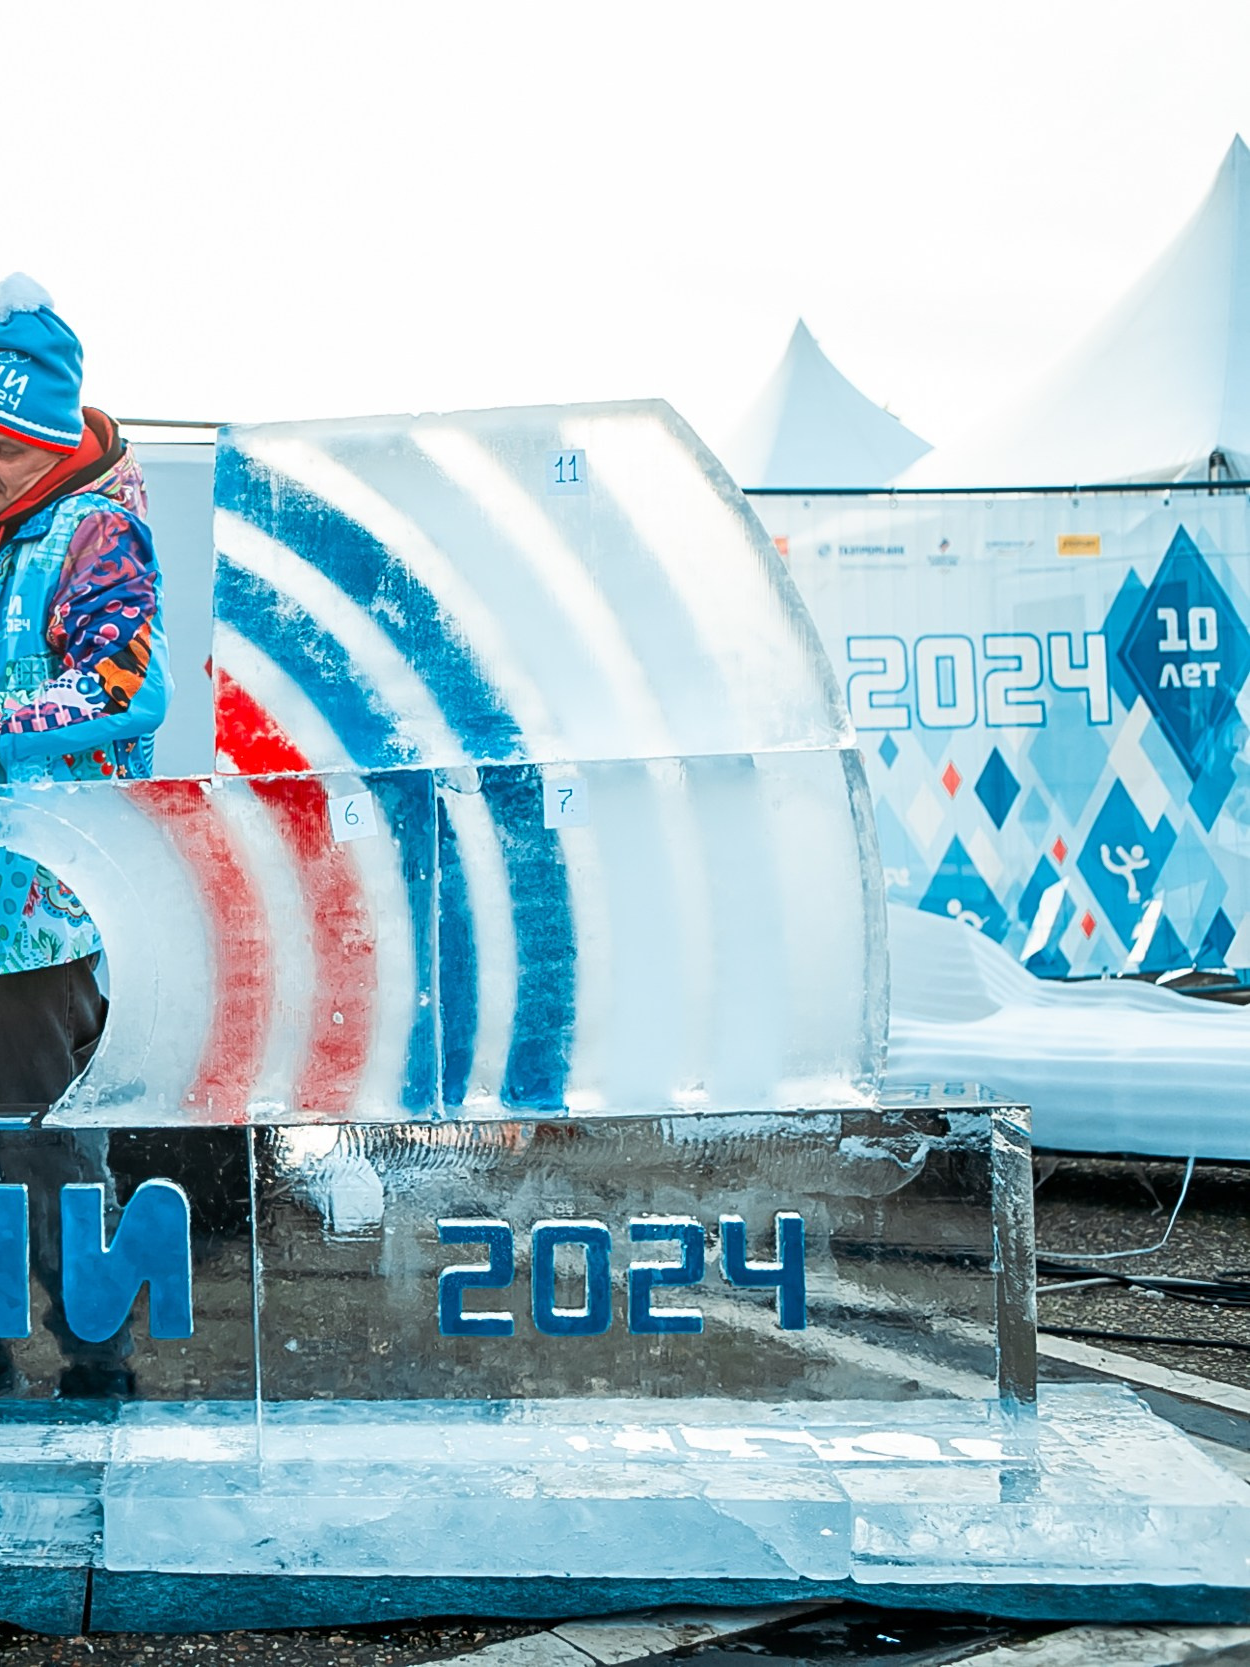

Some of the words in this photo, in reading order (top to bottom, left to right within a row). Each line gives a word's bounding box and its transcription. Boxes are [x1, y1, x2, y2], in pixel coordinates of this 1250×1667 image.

[1157, 606, 1218, 652] 10
[847, 631, 1112, 731] 2024
[437, 1211, 807, 1337] 2024
